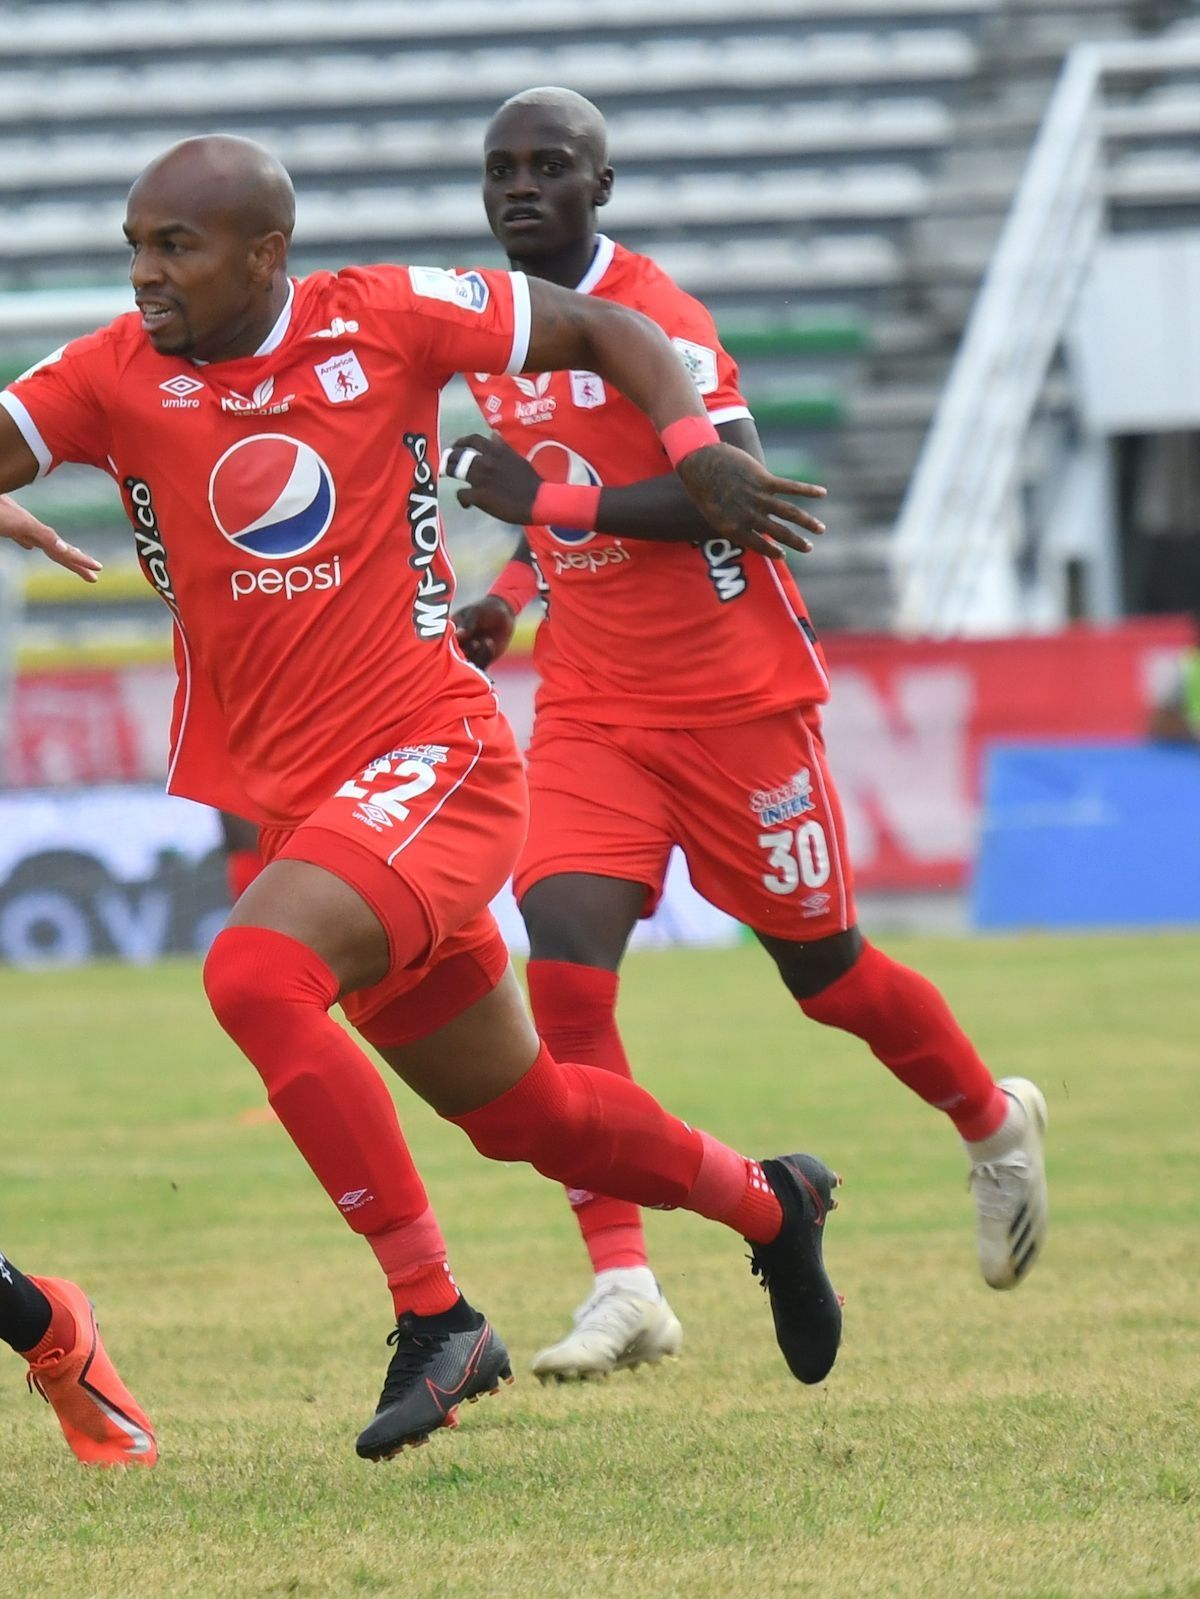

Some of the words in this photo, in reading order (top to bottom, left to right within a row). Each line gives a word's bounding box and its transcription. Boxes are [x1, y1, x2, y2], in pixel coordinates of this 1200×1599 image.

[161, 397, 200, 409] umbro
[553, 539, 631, 575] pepsi
[230, 555, 342, 601] pepsi
[351, 810, 383, 833] umbro
[758, 820, 831, 895] 30
